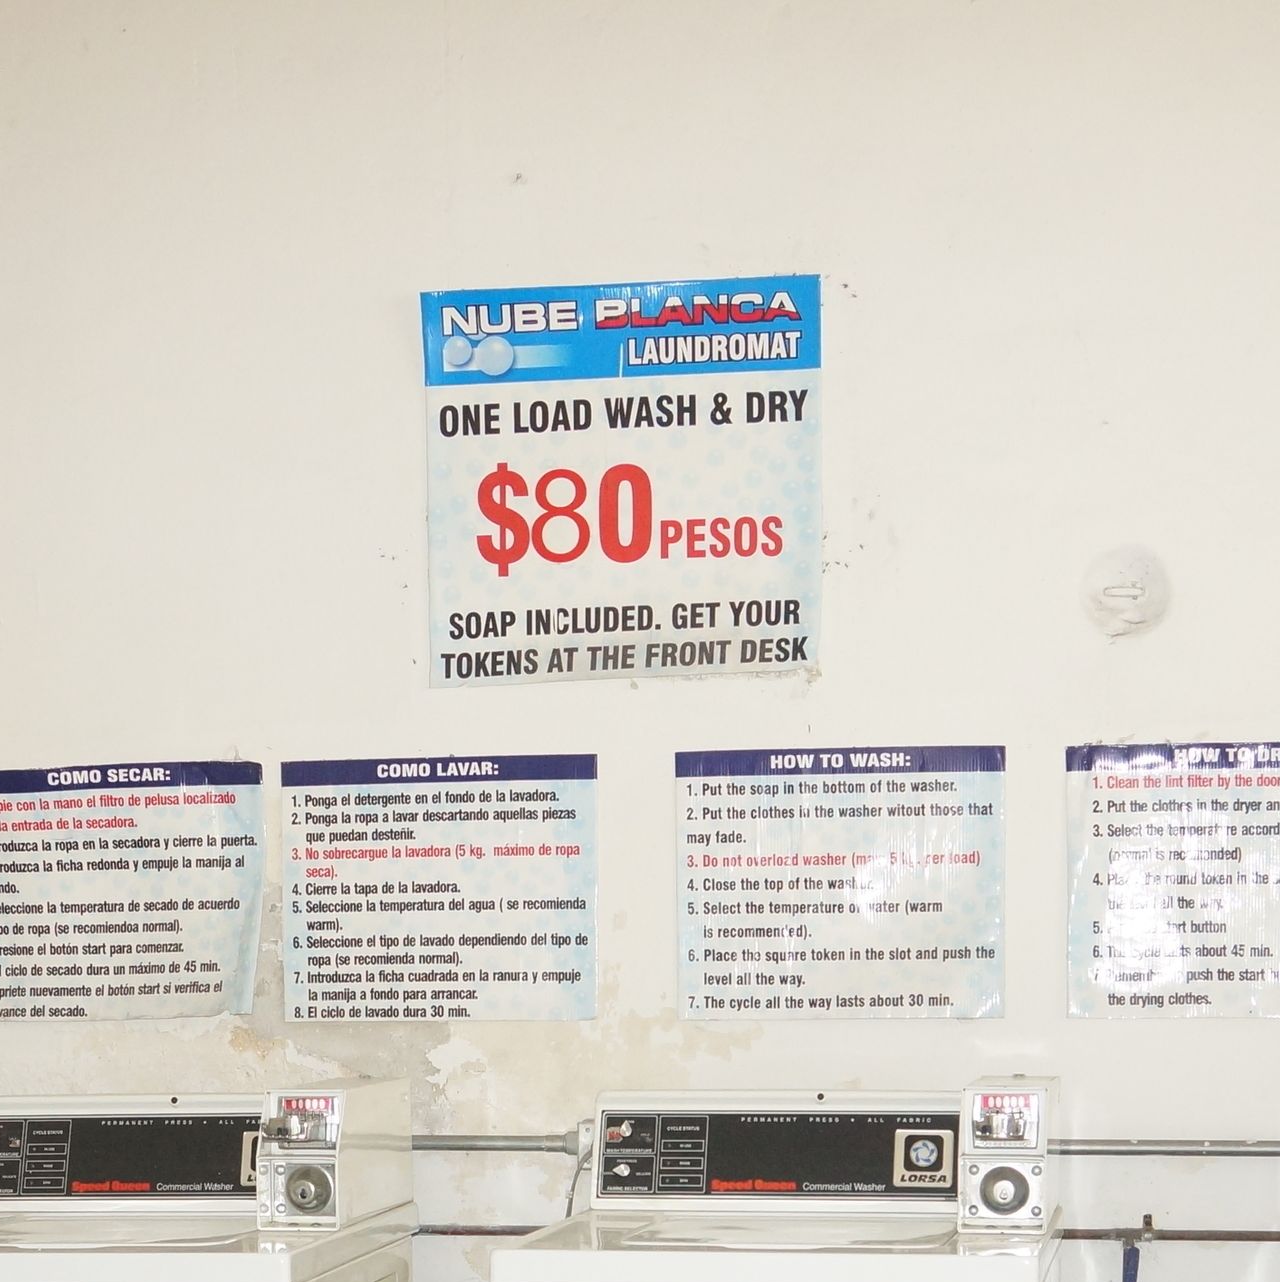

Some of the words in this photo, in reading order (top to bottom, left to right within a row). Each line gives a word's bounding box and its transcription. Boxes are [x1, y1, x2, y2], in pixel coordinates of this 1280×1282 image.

[442, 301, 578, 336] NUBE
[595, 291, 802, 330] BLANCA
[628, 331, 802, 366] LAUNDROMAT
[439, 403, 501, 438] ONE
[513, 399, 591, 434] LOAD
[604, 394, 696, 429] WASH
[710, 392, 732, 425] &
[746, 389, 808, 424] DRY
[476, 463, 652, 577] $80
[660, 516, 783, 559] PESOS
[449, 610, 515, 640] SOAP
[526, 605, 661, 636] INCLUDED.
[671, 602, 720, 629] GET
[729, 599, 800, 627] YOUR
[441, 648, 538, 679] TOKENS
[547, 646, 578, 673] AT
[586, 643, 635, 670] THE
[645, 640, 731, 668] FRONT
[740, 636, 808, 664] DESK
[770, 754, 814, 769] HOW
[820, 754, 844, 768] TO
[850, 752, 911, 767] WASH:
[1174, 748, 1220, 763] HOW
[1225, 748, 1247, 762] TO
[47, 770, 102, 786] COMO
[107, 768, 171, 783] SECAR:
[377, 763, 430, 778] COMO
[437, 762, 499, 777] LAVAR:
[687, 783, 697, 796] 1.
[703, 782, 722, 795] Put
[727, 782, 745, 795] the
[751, 784, 778, 796] soap
[784, 781, 794, 794] in
[799, 781, 817, 794] the
[823, 780, 865, 793] bottom
[870, 780, 881, 792] of
[886, 779, 905, 792] the
[911, 778, 957, 792] washer.
[1093, 775, 1102, 788] 1.
[1107, 775, 1139, 788] Clean
[1143, 775, 1161, 788] the
[1166, 775, 1183, 787] lint
[1187, 774, 1213, 787] filter
[1218, 774, 1230, 789] by
[1235, 774, 1252, 787] the
[16, 800, 36, 811] con
[39, 797, 49, 810] la
[53, 799, 83, 810] mano
[87, 796, 96, 809] el
[100, 795, 124, 808] filtro
[128, 794, 141, 807] de
[145, 793, 179, 809] pelusa
[184, 791, 236, 806] localizado
[11, 818, 53, 831] entrada
[57, 817, 69, 830] de
[73, 817, 82, 830] la
[86, 816, 137, 829] secadora.
[292, 847, 301, 860] 3.
[306, 847, 319, 860] No
[323, 846, 388, 861] sobrecargue
[392, 845, 401, 858] la
[405, 845, 451, 858] lavadora
[456, 844, 465, 859] (5
[470, 844, 485, 859] kg.
[494, 843, 534, 857] máximo
[539, 843, 551, 856] de
[556, 845, 580, 858] ropa
[306, 865, 337, 880] seca).
[38, 942, 46, 955] el
[50, 942, 78, 955] botón
[82, 941, 106, 954] start
[110, 944, 132, 956] para
[1195, 945, 1227, 958] about
[1231, 945, 1245, 957] 45
[1250, 945, 1273, 957] min.
[688, 995, 699, 1008] 7.
[704, 995, 725, 1008] The
[730, 994, 760, 1009] cycle
[766, 994, 780, 1007] all
[785, 994, 803, 1007] the
[809, 996, 831, 1008] way
[836, 993, 865, 1006] lasts
[869, 993, 904, 1006] about
[909, 992, 923, 1005] 30
[929, 992, 953, 1005] min.
[1108, 992, 1125, 1005] the
[1130, 992, 1164, 1007] drying
[1169, 991, 1211, 1004] clothes.
[295, 1005, 304, 1018] 8.
[308, 1005, 317, 1018] El
[321, 1005, 345, 1018] ciclo
[349, 1005, 361, 1018] de
[365, 1004, 399, 1017] lavado
[403, 1004, 426, 1017] dura
[431, 1004, 444, 1017] 30
[448, 1004, 470, 1017] min.
[900, 1174, 947, 1183] LORSA
[156, 1183, 202, 1191] Commercial
[802, 1182, 853, 1191] Commercial
[854, 1183, 886, 1192] Washer
